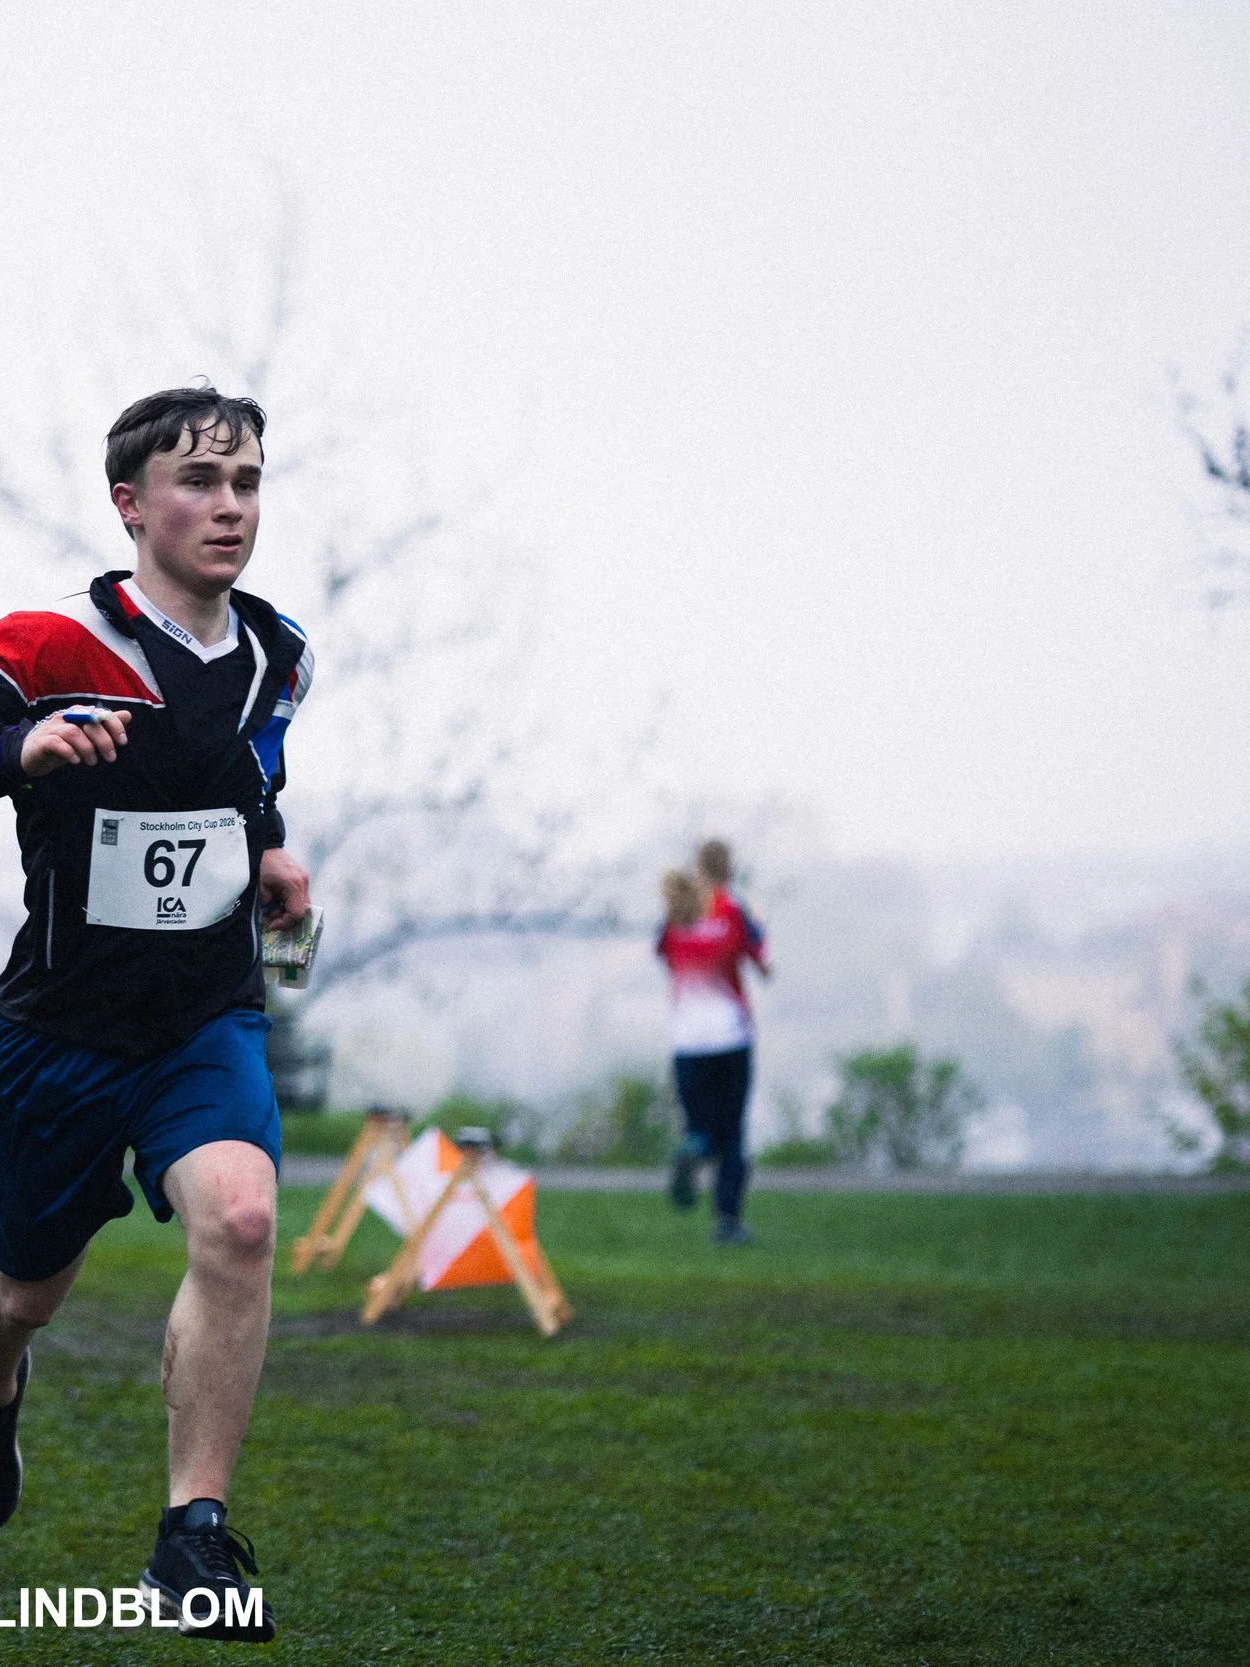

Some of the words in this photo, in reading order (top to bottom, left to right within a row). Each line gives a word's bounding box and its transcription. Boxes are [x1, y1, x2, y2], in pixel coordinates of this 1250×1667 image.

[140, 821, 185, 831] Stockholm
[187, 821, 202, 832] City
[204, 819, 218, 829] Cup
[219, 817, 236, 828] 2026
[144, 839, 206, 888] 67
[157, 897, 187, 912] ICA
